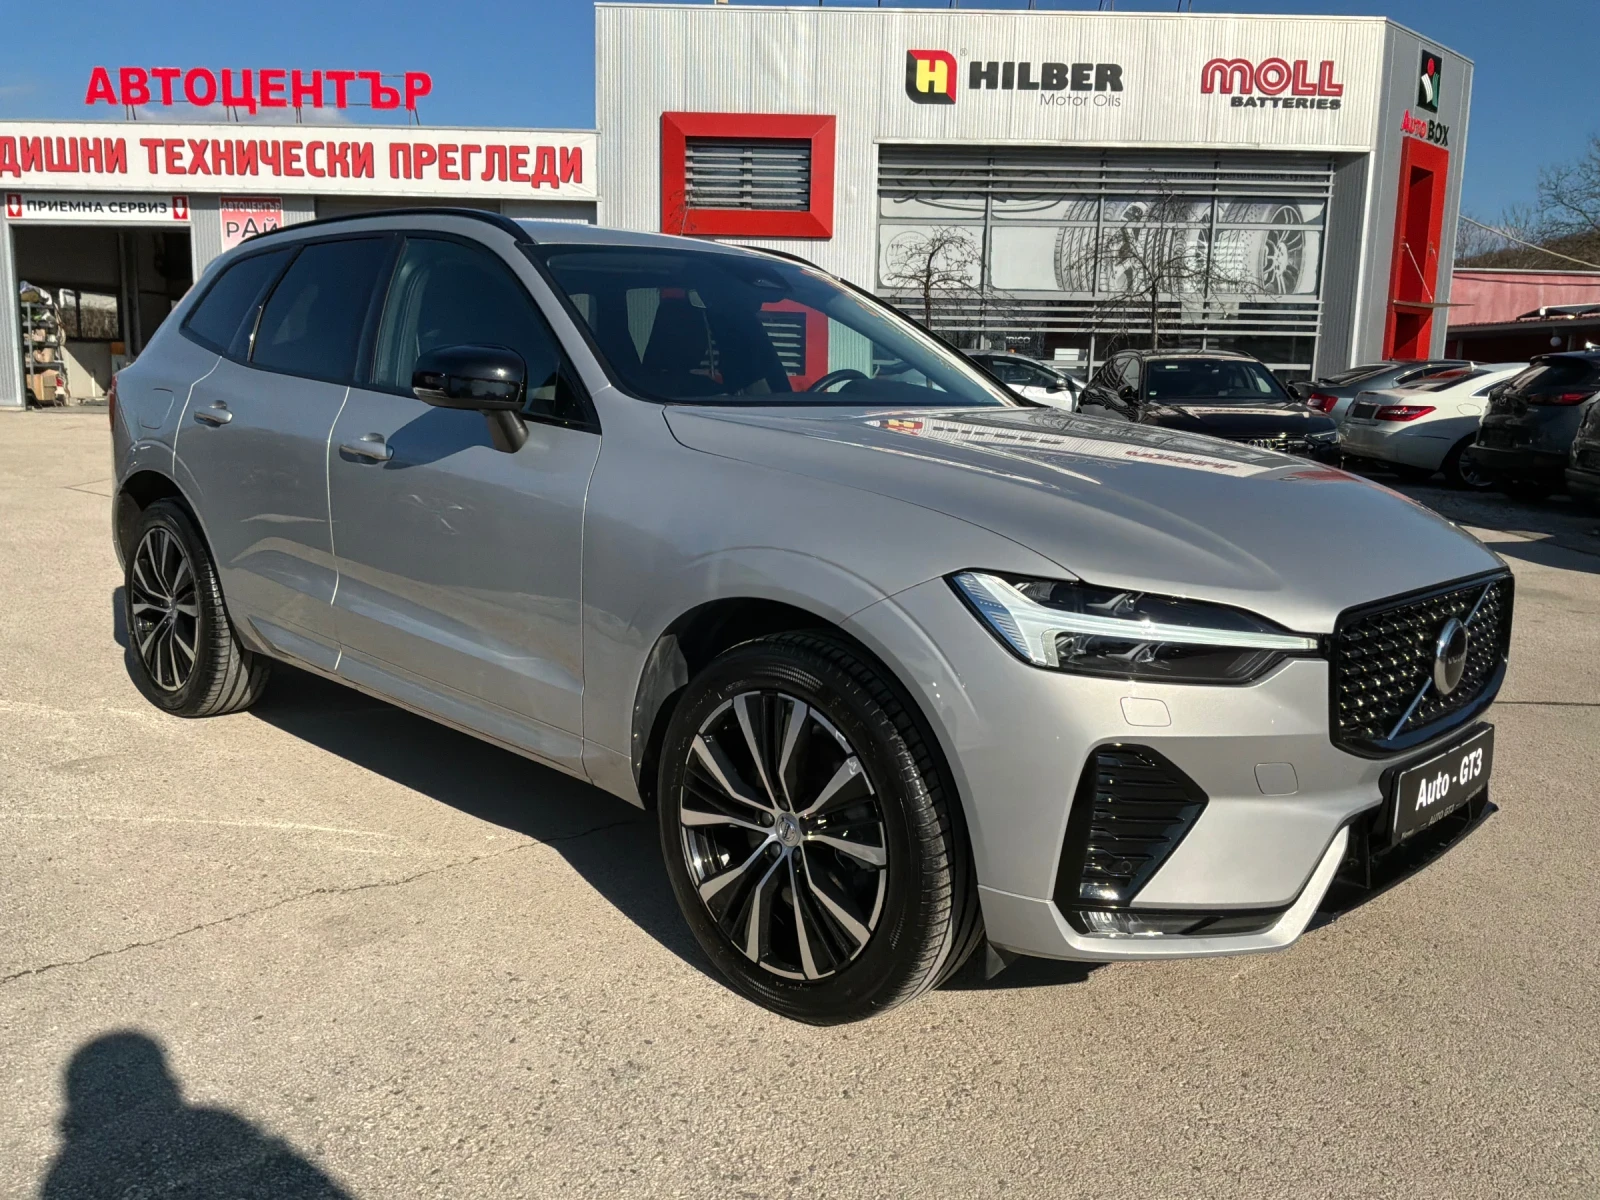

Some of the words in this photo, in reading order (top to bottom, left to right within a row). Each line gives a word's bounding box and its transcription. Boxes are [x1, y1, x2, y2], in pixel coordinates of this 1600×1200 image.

[84, 66, 433, 115] АВТОЦЕНТЪР
[968, 61, 1124, 92] HILBER
[1200, 57, 1344, 97] MOLL
[1040, 93, 1089, 107] Motor
[1093, 93, 1122, 108] Oils
[1230, 96, 1342, 110] BATTERIES
[1427, 119, 1450, 147] BOX
[139, 137, 375, 178] ТЕХНИЧЕСКИ
[389, 142, 583, 189] ПРЕГЛЕДИ
[26, 200, 104, 213] ПРИЕМНА
[108, 201, 168, 214] СЕРВИЗ
[222, 201, 281, 214] АВТОЦЕНТЪР
[1415, 771, 1450, 811] Auto
[1459, 747, 1483, 786] GT3
